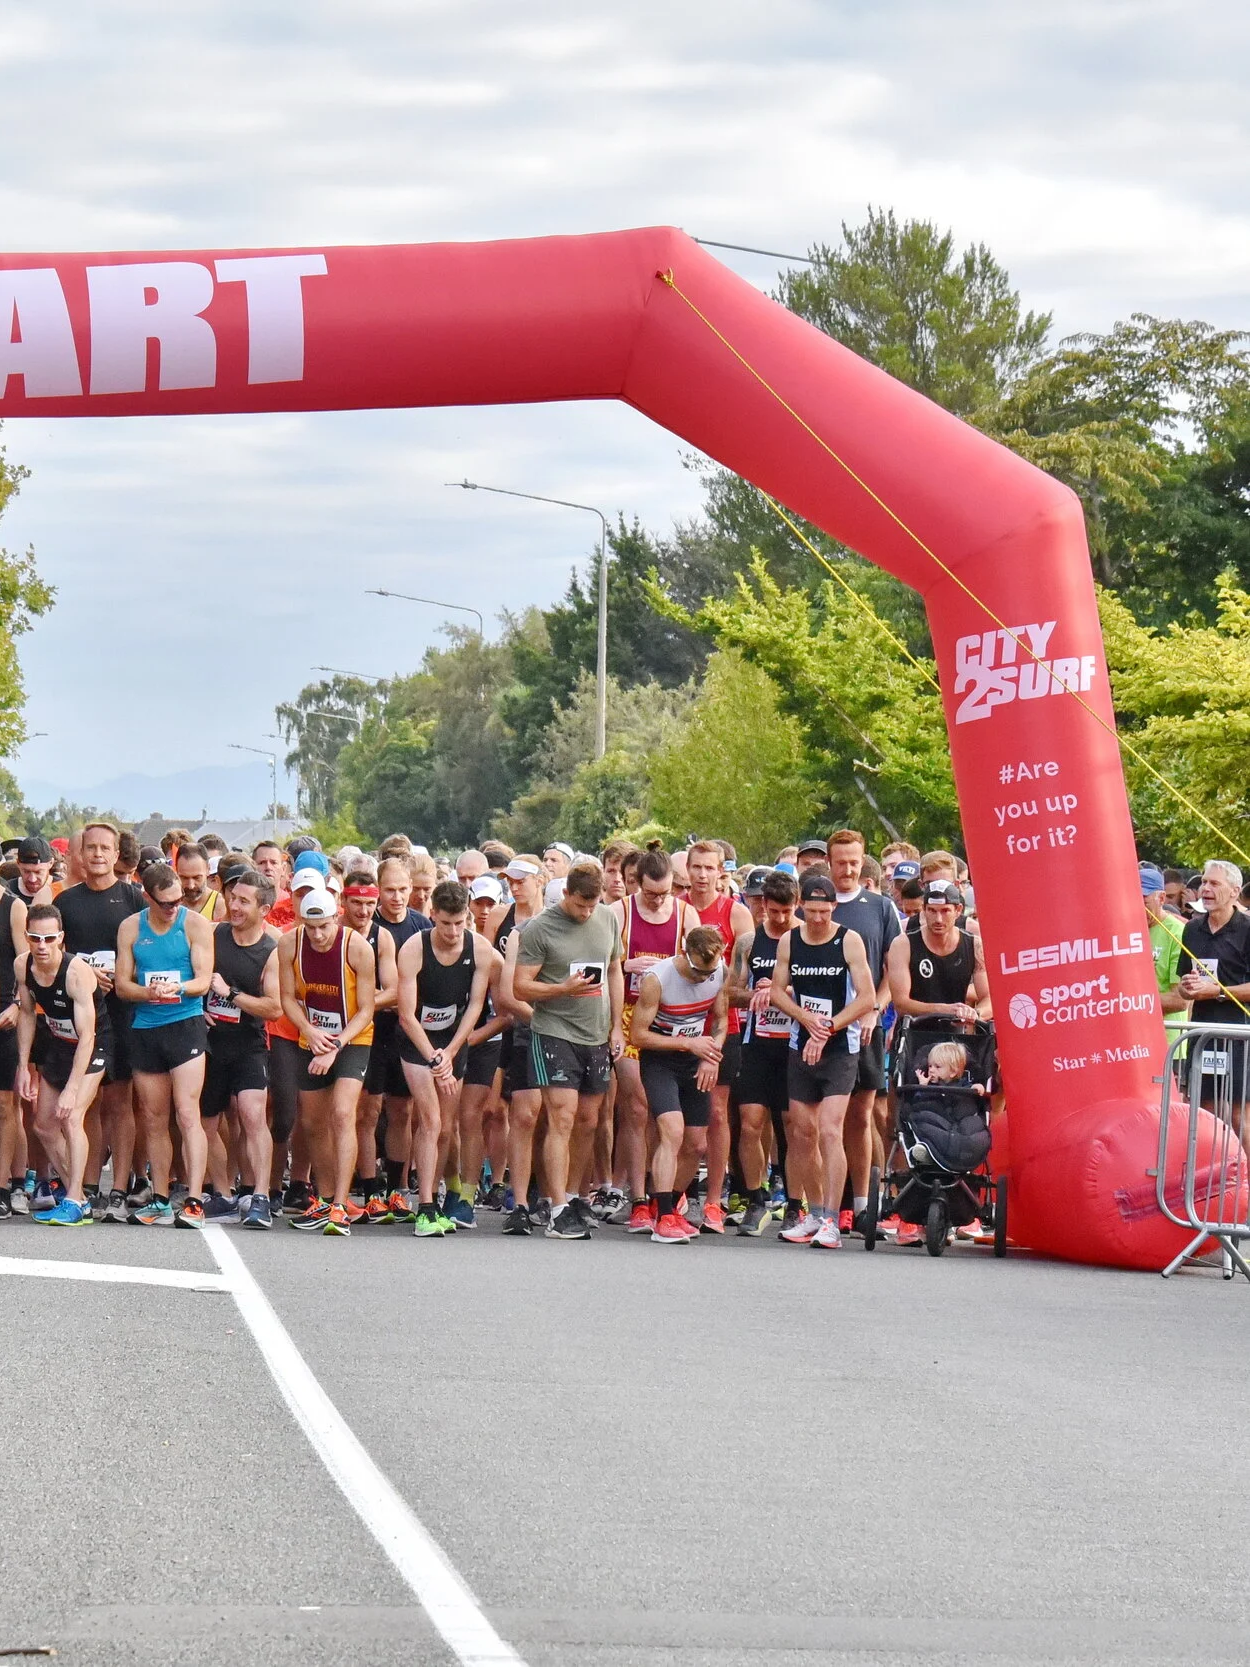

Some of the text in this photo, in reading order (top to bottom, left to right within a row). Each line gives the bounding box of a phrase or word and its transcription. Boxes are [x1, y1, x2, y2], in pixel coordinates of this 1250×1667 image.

[955, 621, 1057, 668] CITY
[954, 655, 1097, 725] 2SURF
[999, 761, 1060, 784] #Are
[994, 794, 1078, 827] you up
[1006, 824, 1077, 855] for it?
[791, 964, 844, 976] Sumner
[304, 982, 339, 993] UNIVERSITY
[1040, 974, 1110, 1008] sport
[804, 1000, 821, 1009] CITY
[1042, 991, 1156, 1025] canterbury
[312, 1018, 339, 1029] 2SURF
[313, 1013, 330, 1021] CITY
[427, 1012, 445, 1020] CITY
[758, 1016, 789, 1026] 2SURF
[678, 1026, 696, 1034] CITY
[1053, 1044, 1150, 1072] Star Media
